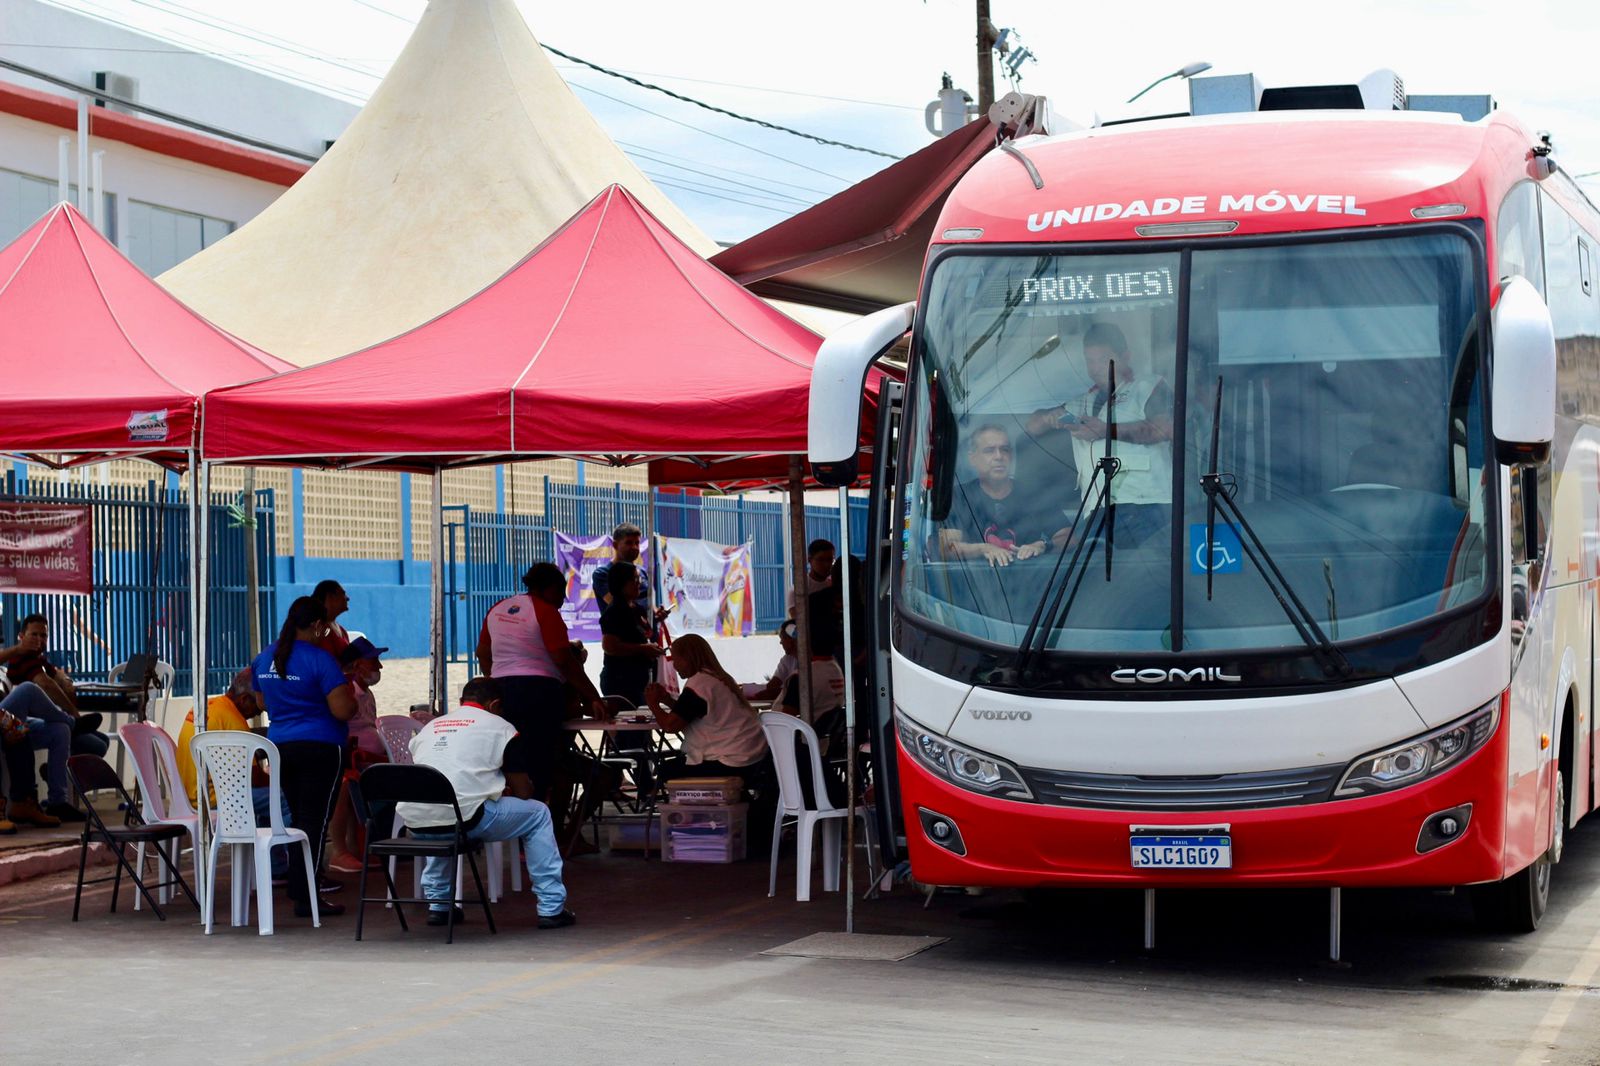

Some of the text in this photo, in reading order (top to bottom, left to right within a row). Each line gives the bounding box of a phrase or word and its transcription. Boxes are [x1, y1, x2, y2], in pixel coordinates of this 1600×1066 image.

[1026, 190, 1367, 233] UNIDADE MÓVEL
[28, 529, 42, 546] de
[9, 550, 40, 569] salve
[1110, 667, 1242, 684] COMIL
[968, 709, 1032, 721] VOLVO
[1140, 847, 1220, 866] SLC1G09
